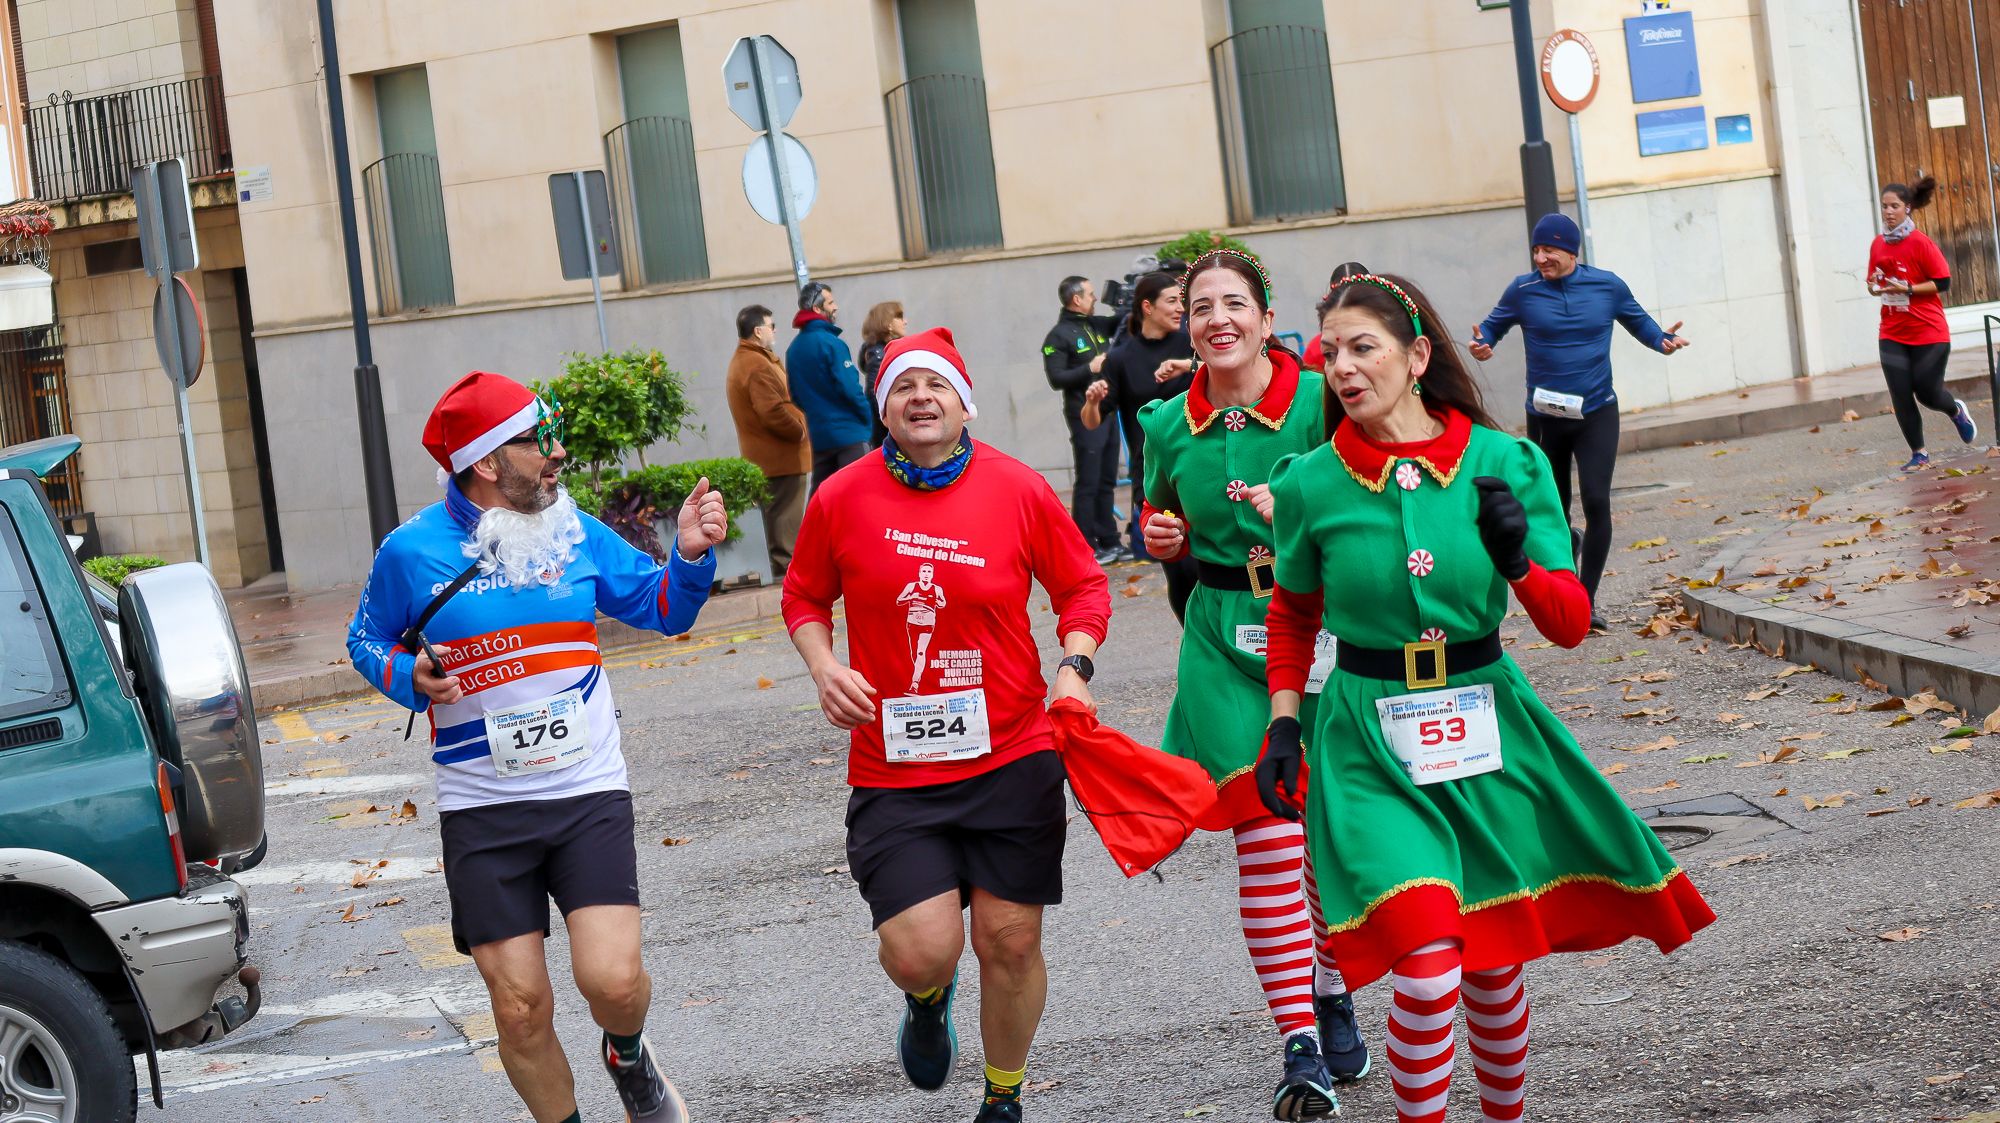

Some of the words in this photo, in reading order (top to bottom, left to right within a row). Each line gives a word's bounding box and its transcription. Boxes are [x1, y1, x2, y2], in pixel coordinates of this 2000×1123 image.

[884, 528, 892, 540] I
[892, 529, 912, 543] San
[912, 532, 959, 550] Silvestre
[896, 543, 934, 559] Ciudad
[934, 549, 948, 561] de
[949, 551, 986, 568] Lucena
[939, 649, 982, 659] MEMORIAL
[930, 659, 950, 668] JOSE
[950, 658, 982, 668] CARLOS
[944, 667, 982, 678] HURTADO
[940, 676, 982, 688] MARJALIZO
[1405, 702, 1436, 710] Silvestre
[496, 716, 508, 724] San
[508, 711, 534, 721] Silvestre
[498, 719, 518, 730] Ciudad
[527, 715, 548, 724] Lucena
[1392, 712, 1416, 720] Ciudad
[512, 719, 568, 750] 176
[906, 716, 966, 740] 524
[1420, 717, 1466, 745] 53
